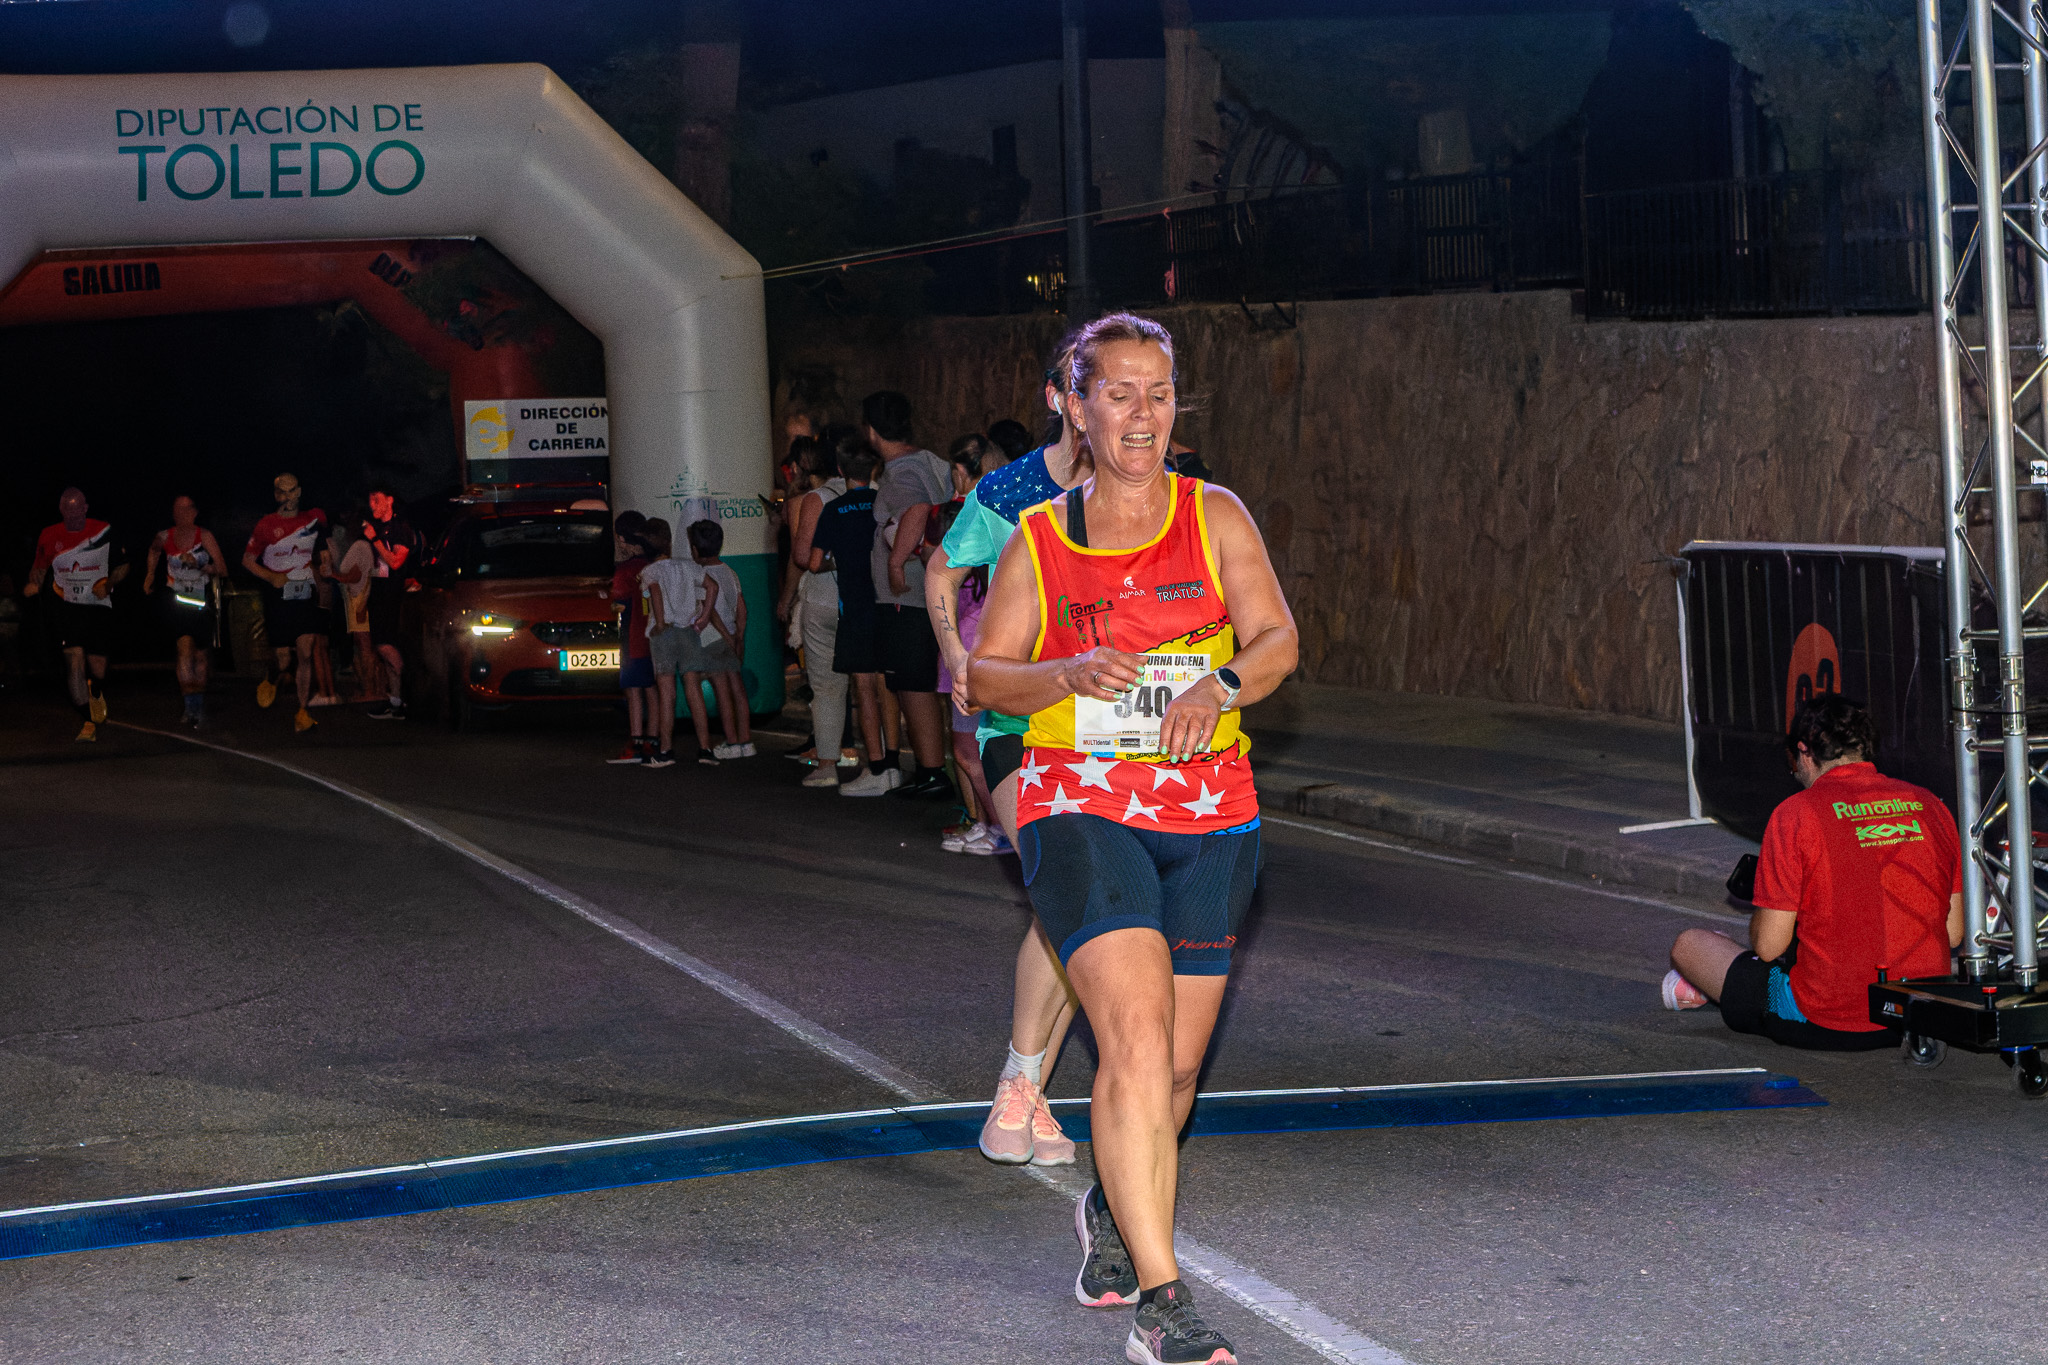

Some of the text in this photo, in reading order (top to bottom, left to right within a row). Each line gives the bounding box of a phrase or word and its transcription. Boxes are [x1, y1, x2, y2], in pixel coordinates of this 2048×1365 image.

[116, 99, 425, 137] DIPUTACIÓN DE
[118, 139, 426, 202] TOLEDO
[63, 262, 161, 296] SALIDA
[556, 423, 578, 435] DE
[528, 437, 606, 451] CARRERA
[719, 506, 763, 519] TOLEDO
[571, 653, 608, 667] 0282
[1147, 655, 1204, 667] URNA UGENA
[1114, 686, 1173, 719] 340
[1855, 819, 1922, 841] KON
